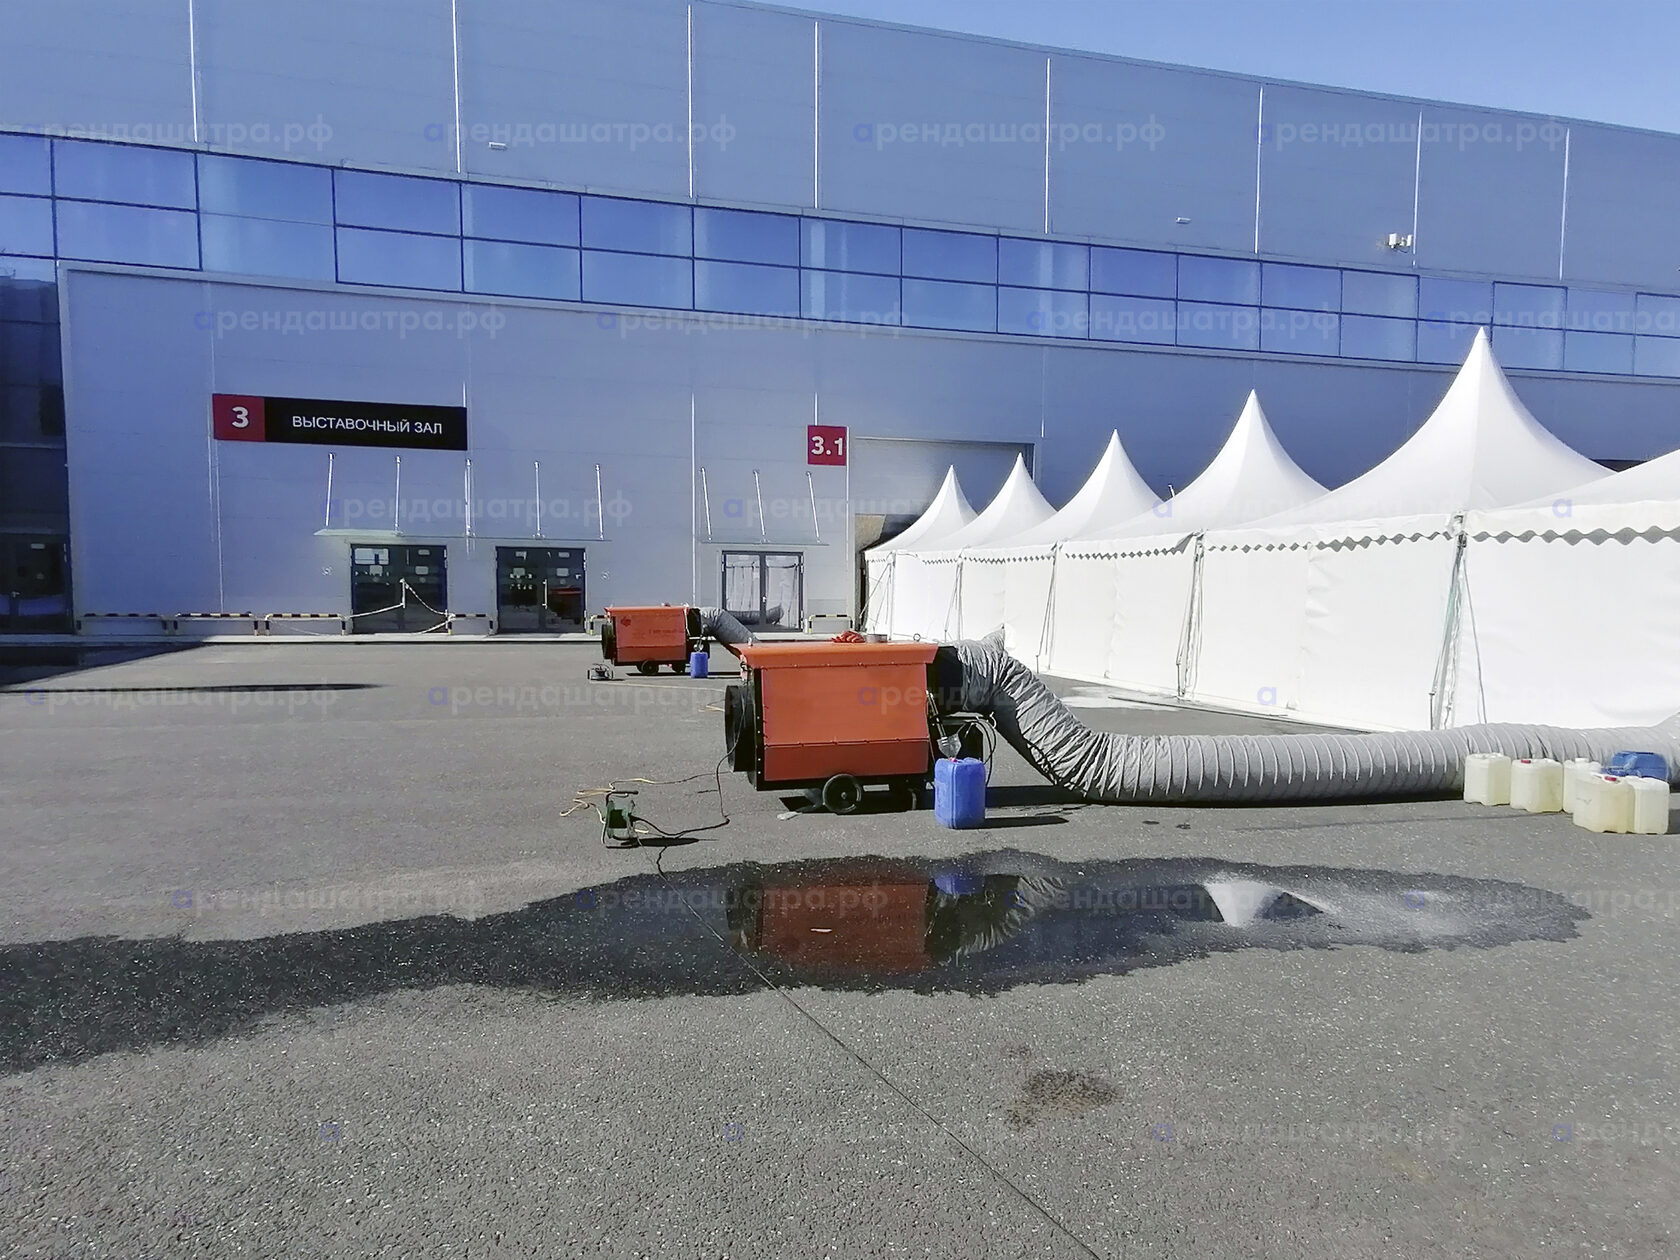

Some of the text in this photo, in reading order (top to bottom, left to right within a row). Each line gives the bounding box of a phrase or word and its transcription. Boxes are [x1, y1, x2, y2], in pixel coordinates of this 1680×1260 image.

[231, 406, 443, 435] 3 ВЫСТАВОЧНЫЙ ЗАЛ
[811, 435, 843, 456] 3.1
